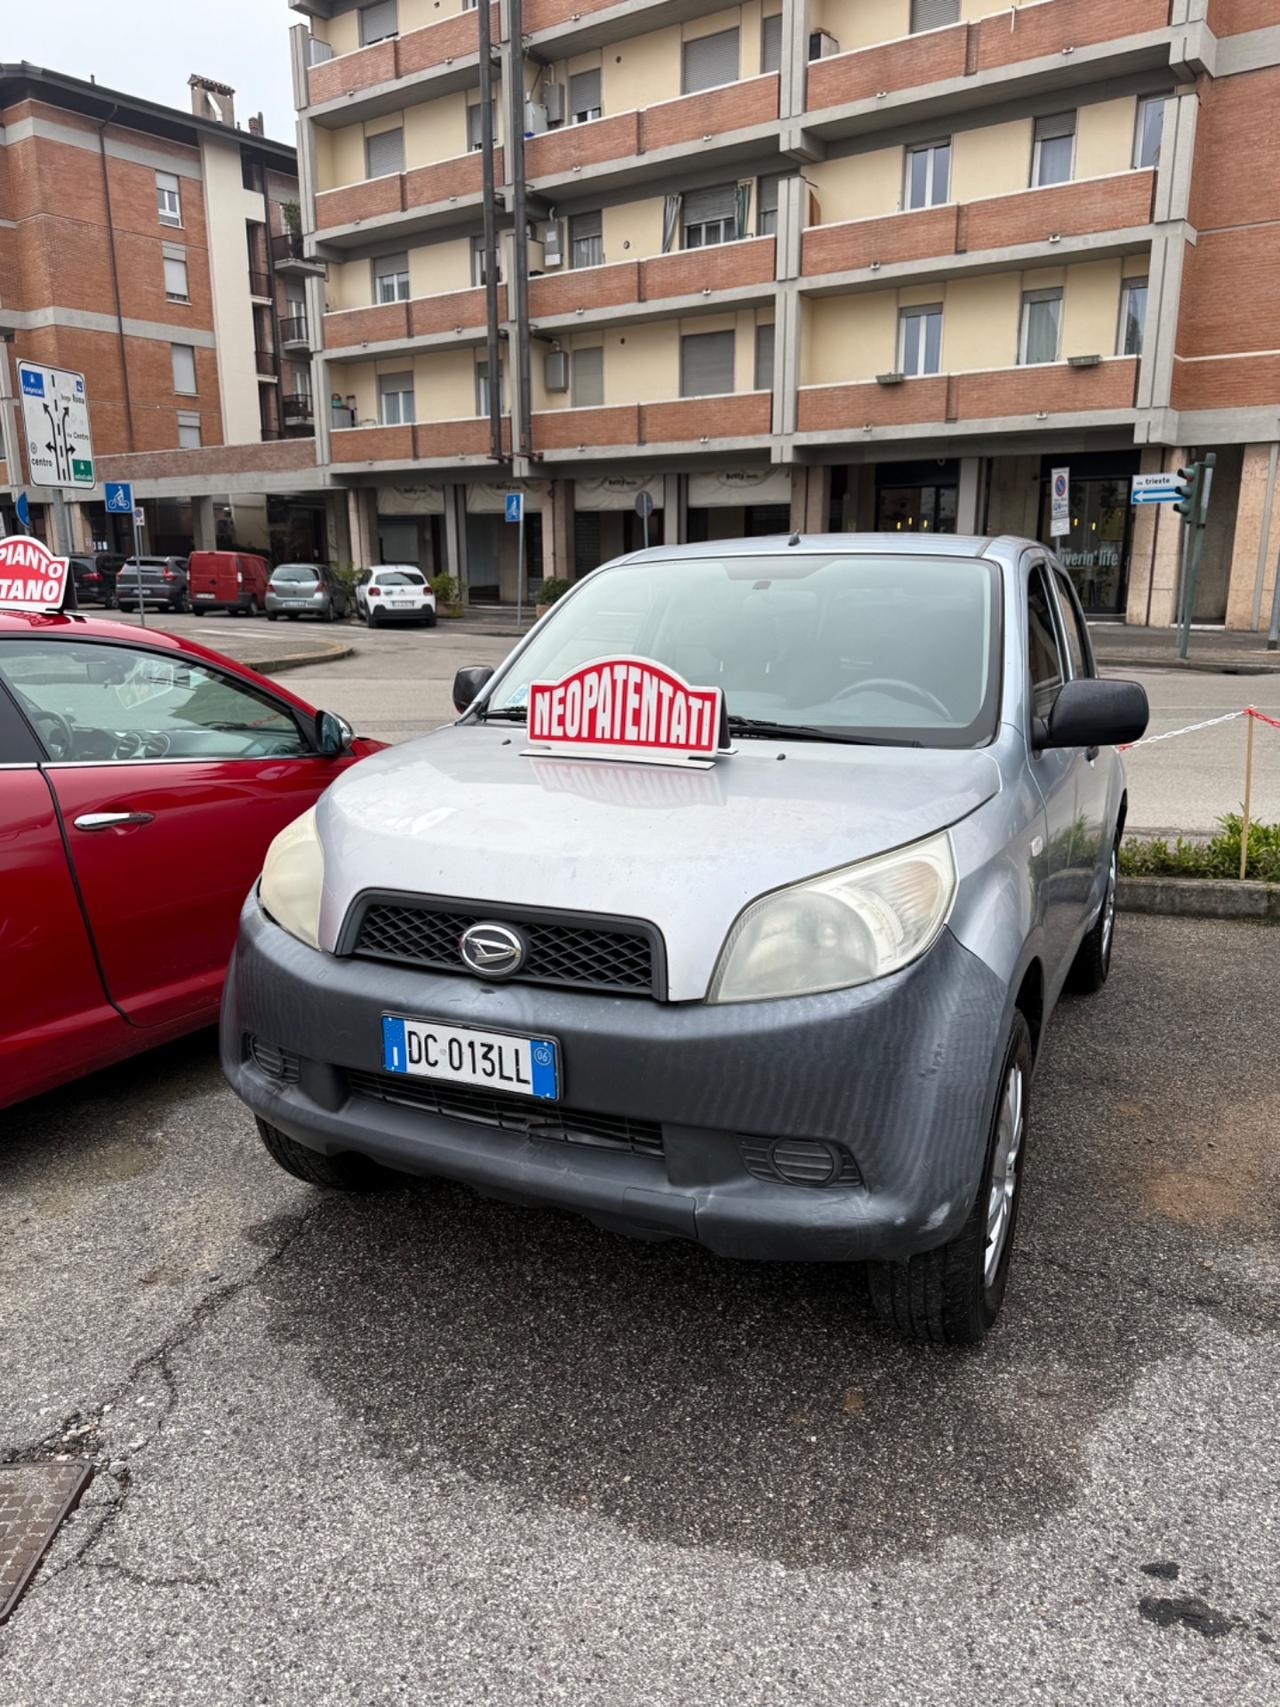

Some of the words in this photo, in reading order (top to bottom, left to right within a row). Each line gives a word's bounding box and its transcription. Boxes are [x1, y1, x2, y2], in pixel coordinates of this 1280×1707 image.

[31, 458, 53, 468] centro
[1145, 477, 1170, 485] trieste
[1099, 550, 1118, 567] life
[0, 579, 60, 601] TANO
[534, 665, 711, 746] NEOPATENTATI
